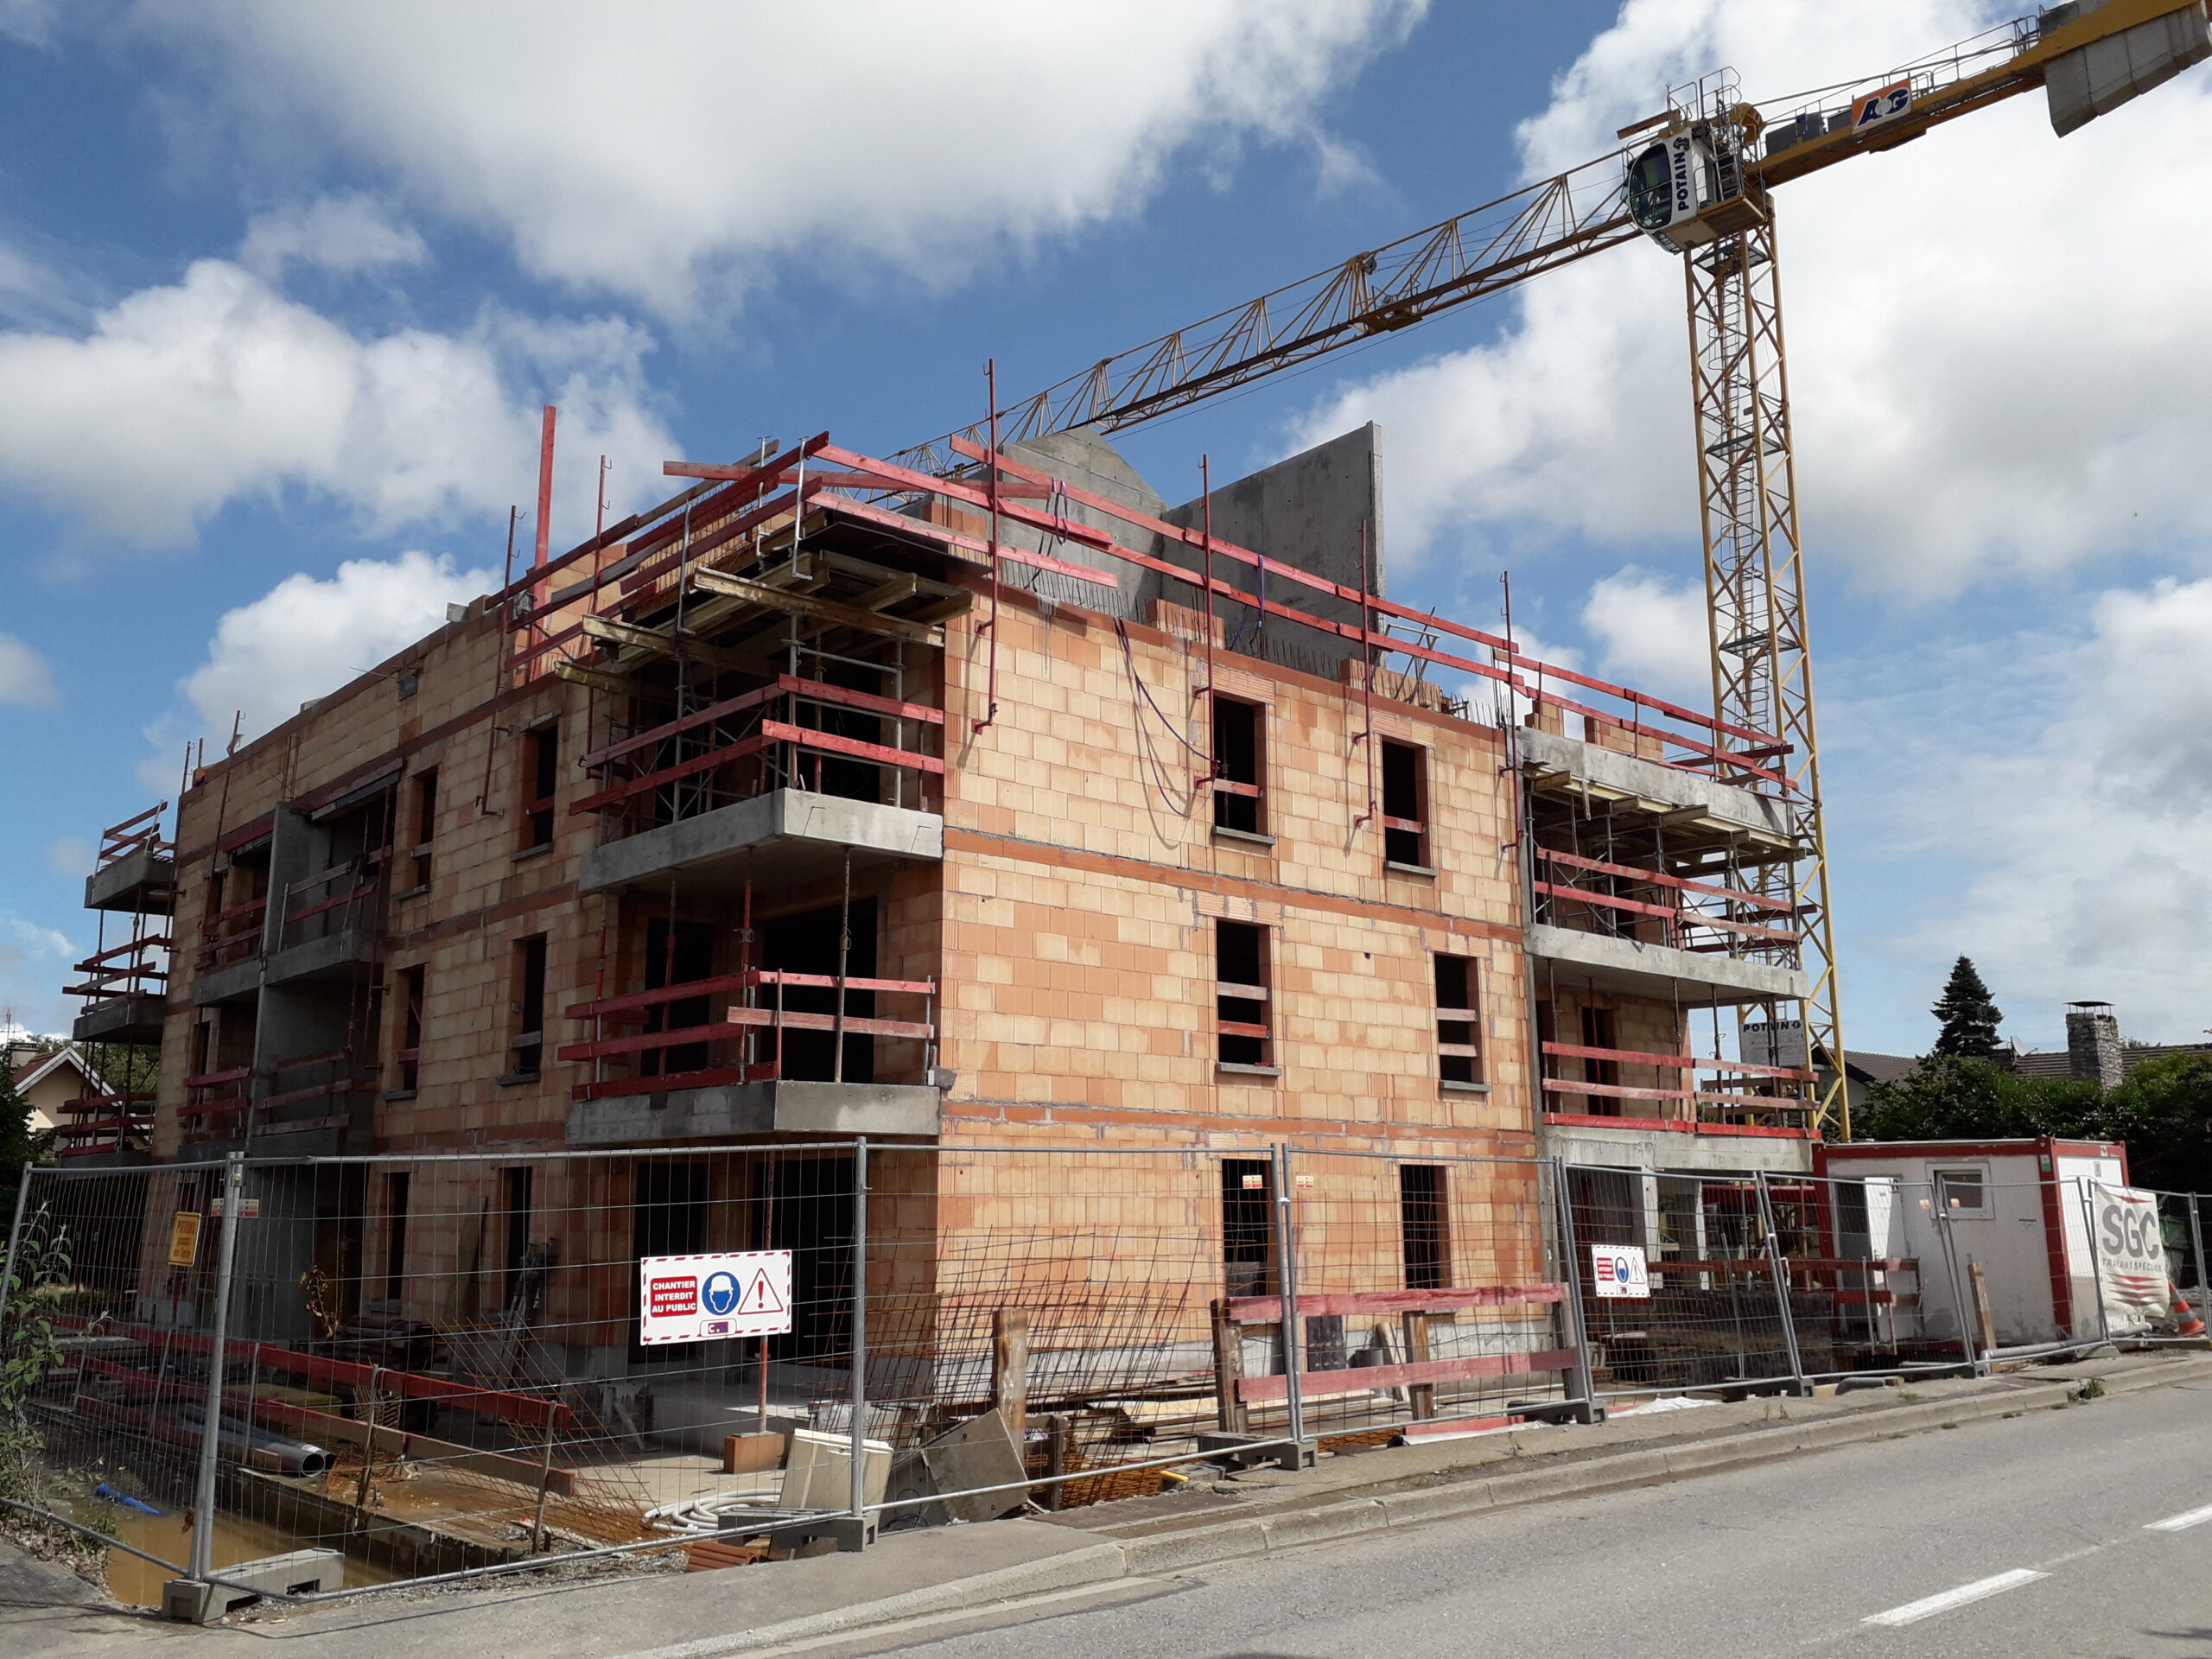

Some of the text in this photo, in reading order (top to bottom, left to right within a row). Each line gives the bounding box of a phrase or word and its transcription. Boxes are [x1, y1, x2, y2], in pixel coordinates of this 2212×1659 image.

[1674, 152, 1689, 212] POTAIN
[2101, 1205, 2160, 1260] SGC
[652, 1281, 696, 1291] CHANTIER
[654, 1292, 694, 1302] INTERDIT
[652, 1303, 696, 1313] AU PUBLIC
